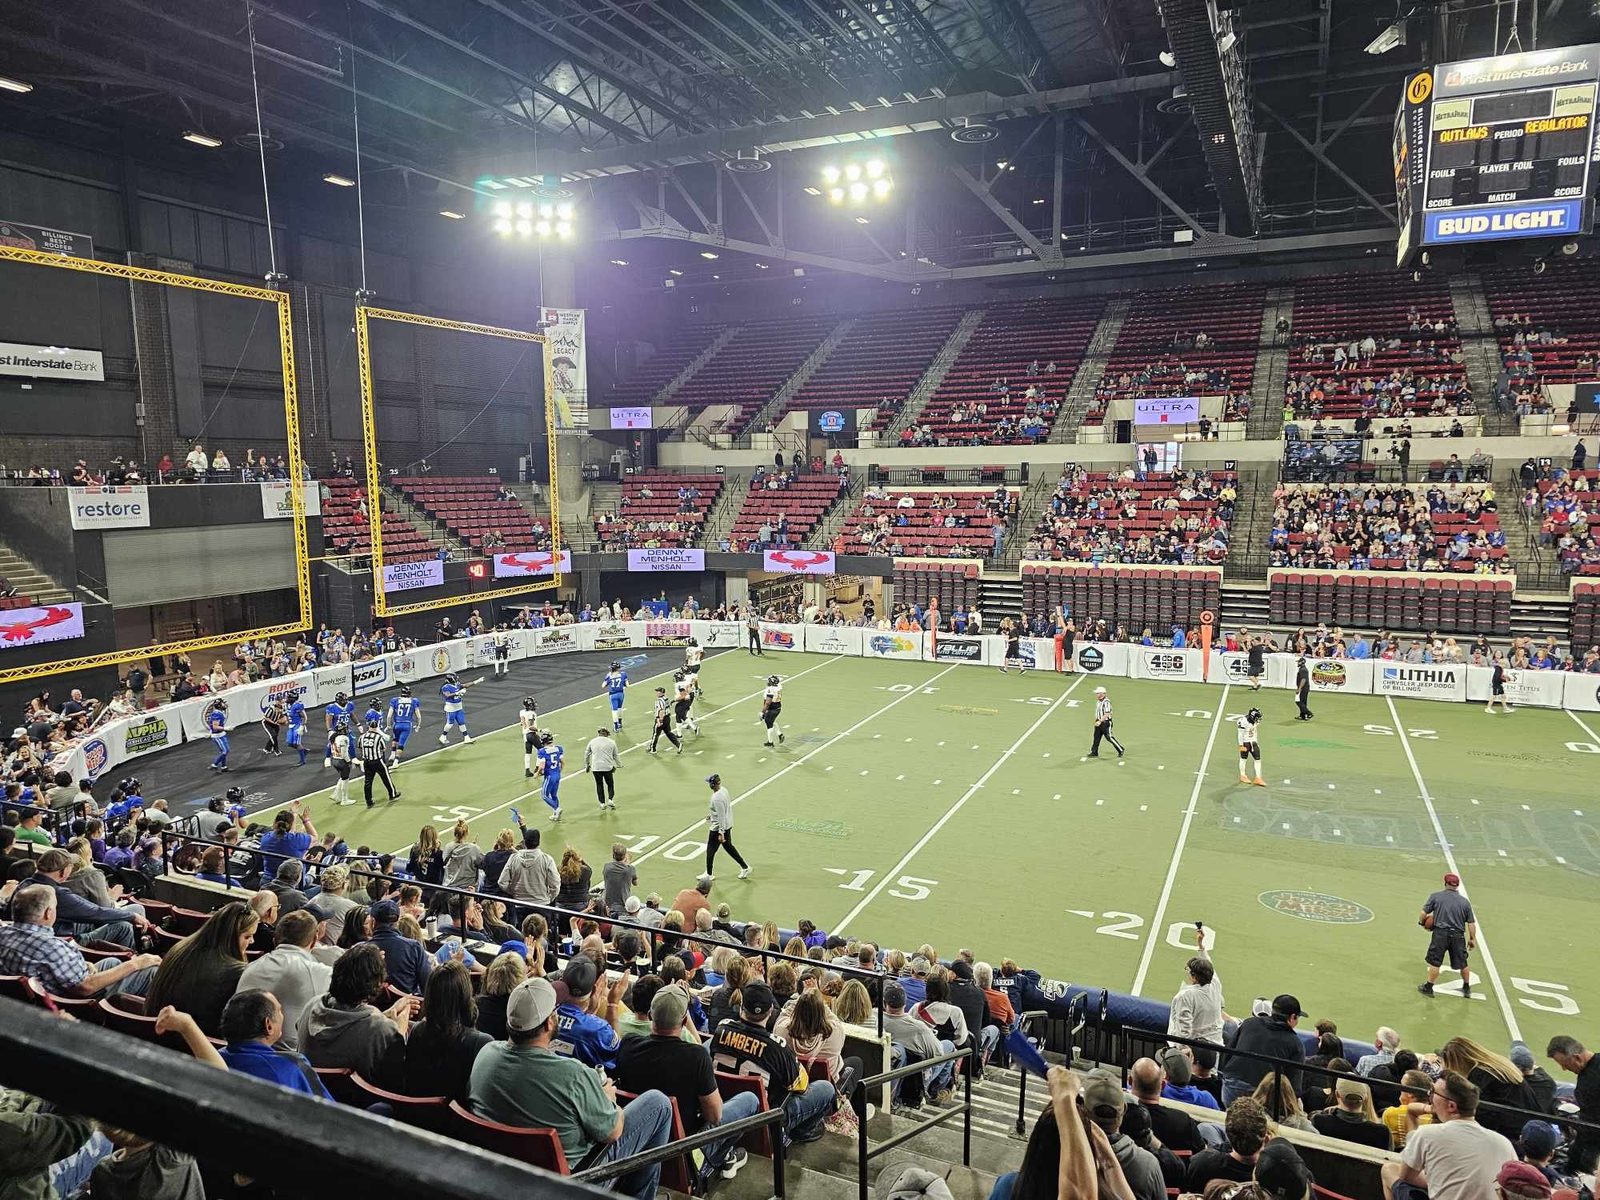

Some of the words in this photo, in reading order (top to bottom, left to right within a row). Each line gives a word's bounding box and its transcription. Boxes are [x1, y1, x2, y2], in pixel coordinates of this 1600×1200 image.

[1492, 65, 1560, 81] Interstate
[1560, 59, 1589, 74] Bank
[1525, 116, 1588, 133] REGULATOR
[1440, 127, 1488, 142] OUTLAWS
[1494, 128, 1524, 139] PERIOD
[1478, 163, 1510, 174] PLAYER
[1513, 161, 1534, 170] FOUL
[1557, 156, 1585, 166] FOULS
[1430, 169, 1455, 178] FOULS
[1488, 193, 1516, 202] MATCH
[1554, 187, 1581, 196] SCORE
[1428, 199, 1453, 208] SCORE
[1438, 215, 1489, 235] BUD
[41, 231, 73, 241] BILLINGS
[49, 237, 67, 245] BEST
[553, 347, 576, 355] LEGACY
[13, 356, 72, 370] Interstate
[74, 360, 97, 372] Bank
[77, 501, 141, 517] restore
[394, 563, 427, 573] DENNY
[388, 569, 434, 581] MENHOLT
[398, 580, 425, 589] NISSAN
[387, 641, 396, 650] 10
[1230, 659, 1264, 673] 40
[1400, 669, 1456, 683] LITHIA
[269, 681, 298, 693] ROTO-
[611, 678, 622, 688] 17
[268, 686, 307, 702] ROOER
[397, 703, 411, 717] 67
[126, 720, 168, 740] ALPHA
[363, 738, 374, 747] 26
[550, 753, 558, 769] 5
[433, 805, 483, 822] 5
[838, 868, 939, 900] 15
[1095, 910, 1216, 951] 20
[719, 1029, 768, 1058] LAMBERT
